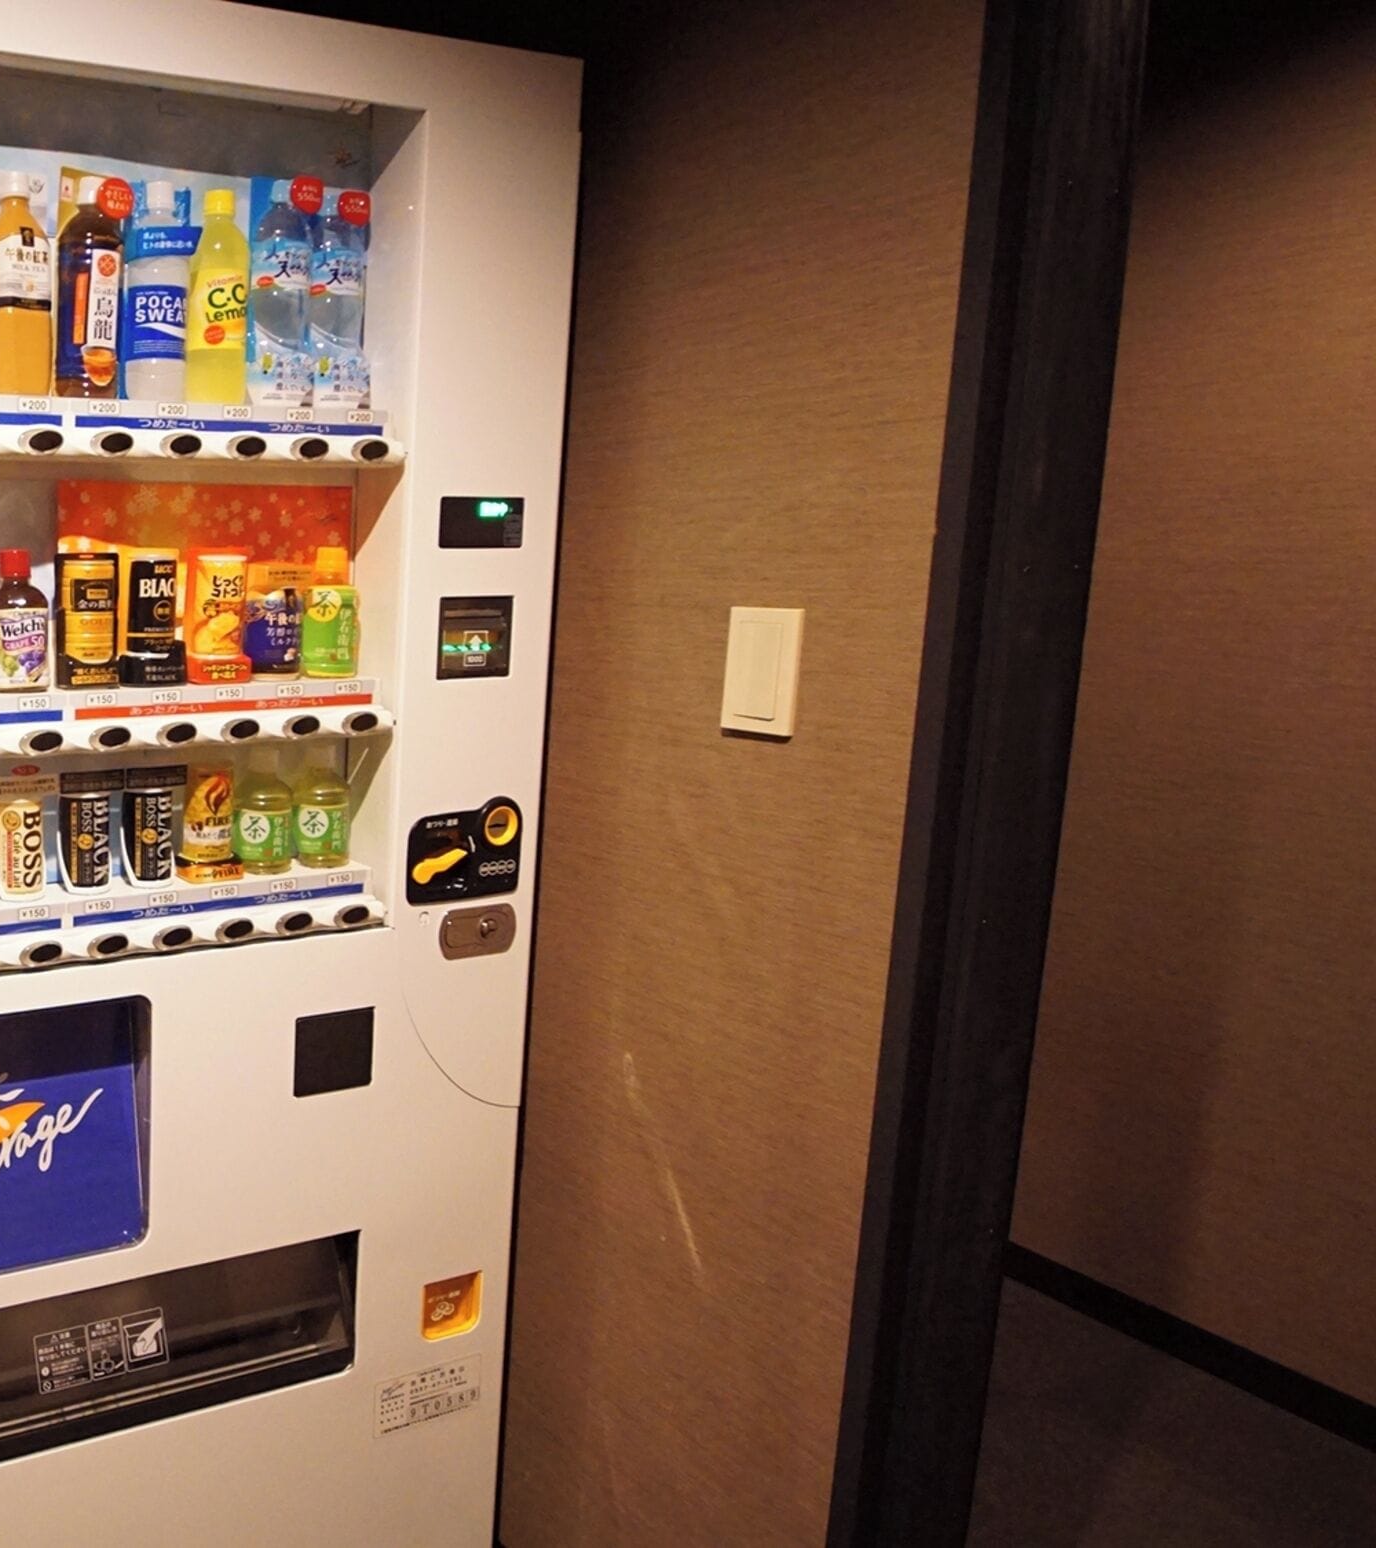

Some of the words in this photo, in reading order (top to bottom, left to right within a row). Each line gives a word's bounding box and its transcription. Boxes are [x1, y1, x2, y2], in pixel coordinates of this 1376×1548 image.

[94, 298, 113, 340] 烏龍
[135, 309, 185, 323] SWEA
[206, 307, 247, 323] Lemo
[139, 578, 175, 597] BLAC
[310, 592, 337, 617] 茶
[81, 801, 93, 832] BOSS
[146, 797, 156, 827] BOSS
[302, 811, 325, 834] 茶
[93, 800, 110, 883] BLACK
[157, 796, 172, 877] BLACK
[244, 816, 266, 840] 茶
[23, 809, 42, 888] BOSS
